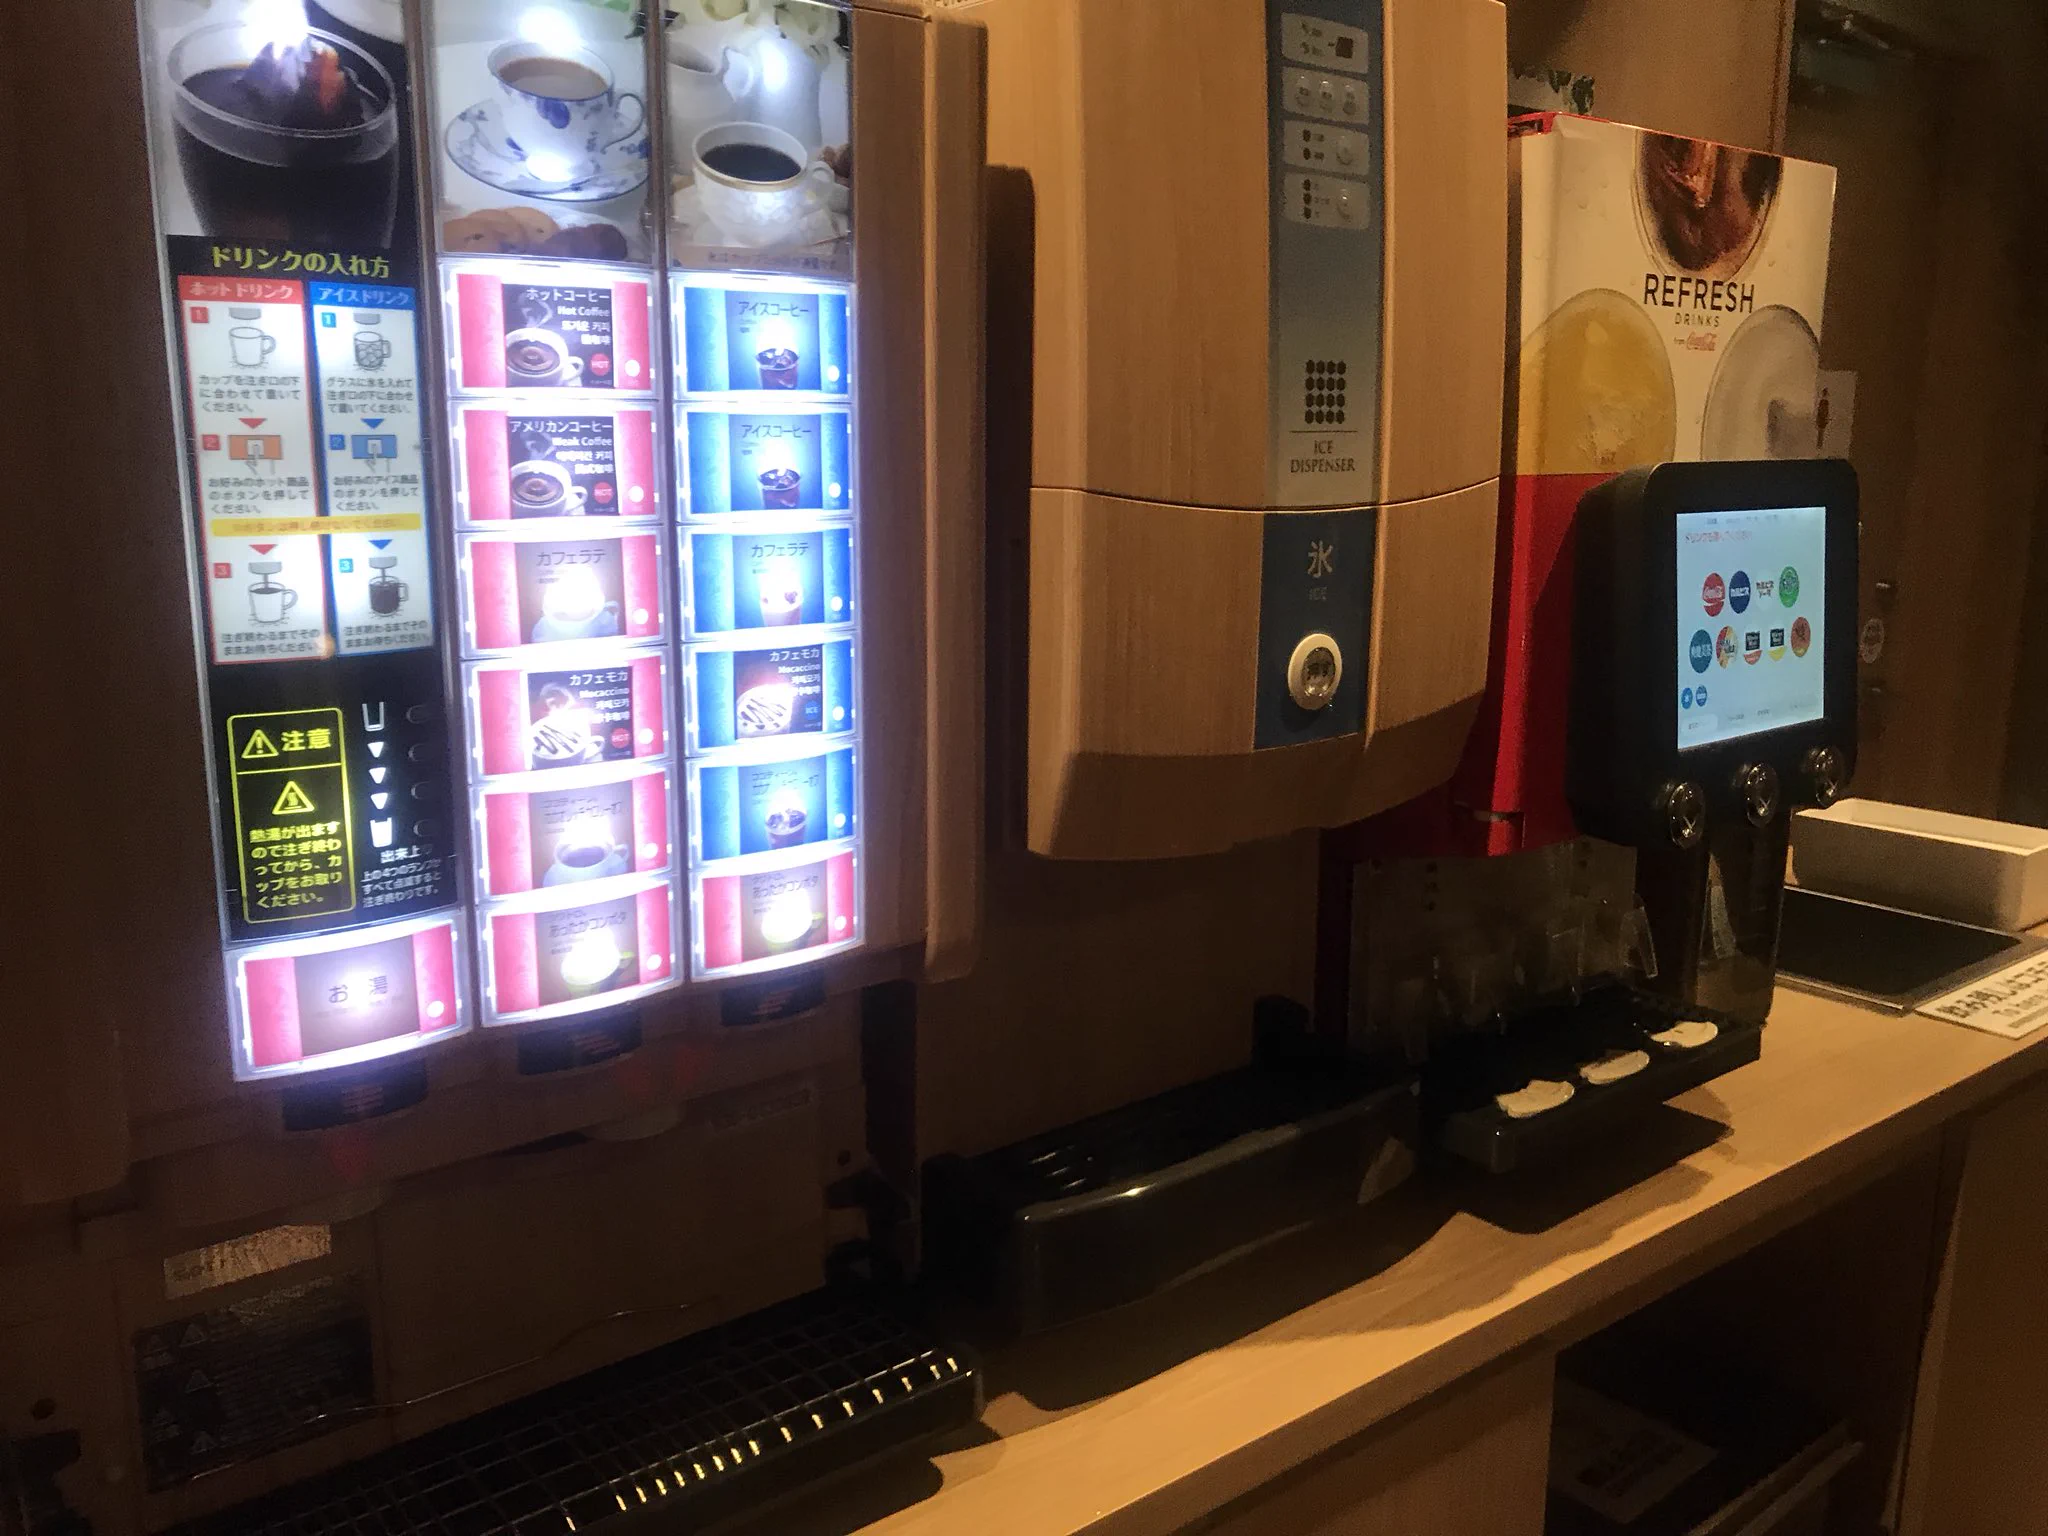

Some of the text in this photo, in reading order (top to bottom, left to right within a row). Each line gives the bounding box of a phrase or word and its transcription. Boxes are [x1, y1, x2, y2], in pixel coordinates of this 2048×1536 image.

[211, 246, 390, 279] ドリンクの入れ方
[189, 281, 293, 299] ホットドリンク
[318, 286, 410, 306] アイスドリンク
[526, 288, 610, 301] ホットコーヒー
[1644, 273, 1755, 314] REFRESH
[557, 306, 610, 317] Hot Coffee
[738, 301, 810, 318] アイスコーヒー
[1674, 312, 1720, 328] DRINKS
[509, 420, 613, 433] アメリカンコーヒー
[741, 424, 812, 439] アイスコーヒー
[552, 437, 613, 447] Weak Coffee
[1313, 438, 1334, 455] ICE
[1290, 457, 1356, 474] DISPENSER
[536, 549, 607, 567] カフェラテ
[751, 542, 810, 559] カフェラテ
[1307, 539, 1334, 579] 氷
[769, 647, 820, 663] カフェモカ
[569, 671, 629, 686] カフェモカ
[281, 728, 332, 752] 注意
[250, 820, 341, 843] 熱湯が出ます
[251, 838, 342, 859] ので注ぎ終わ
[253, 854, 343, 876] ってから、カ
[255, 873, 343, 893] ップをお取り
[256, 892, 325, 909] ください。
[328, 974, 390, 1005] お湯
